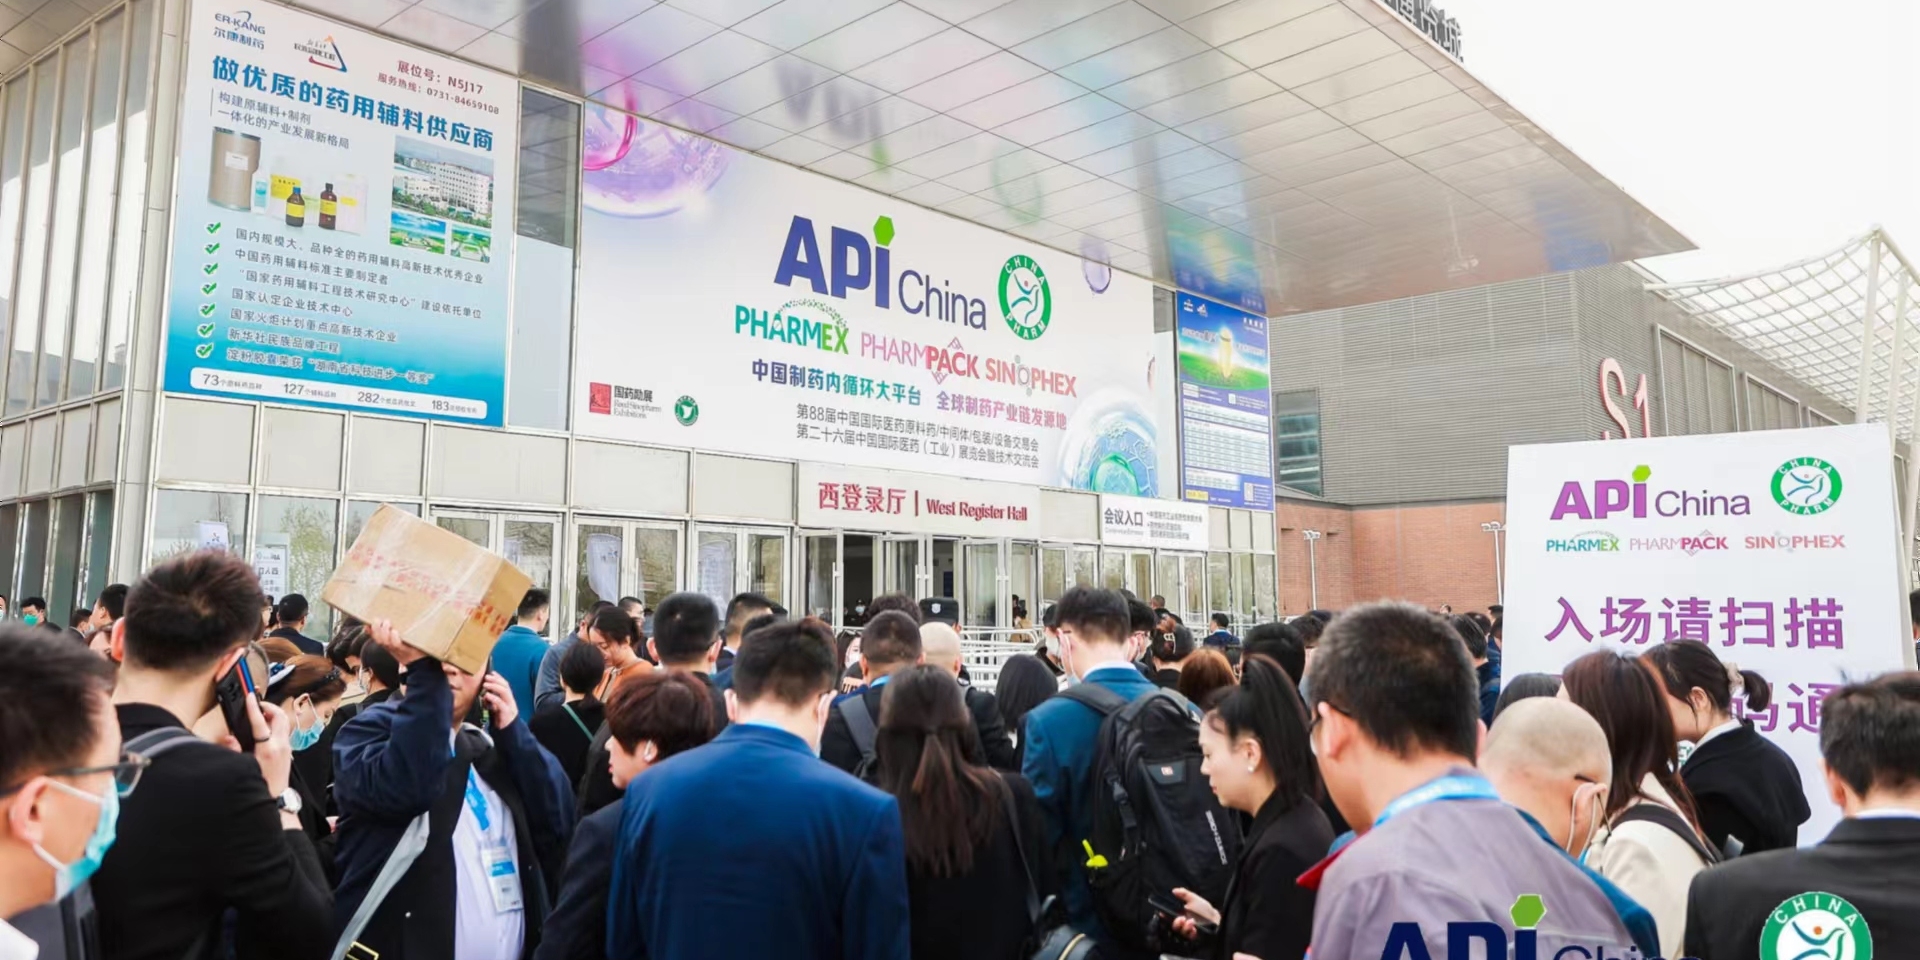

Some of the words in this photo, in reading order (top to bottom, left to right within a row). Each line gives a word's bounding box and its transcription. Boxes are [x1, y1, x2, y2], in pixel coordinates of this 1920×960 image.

[212, 55, 493, 151] 做优质的药用辅料供应商
[219, 91, 311, 125] 构建原辅料+制剂
[218, 109, 350, 149] 一体化的产业发展新格局
[235, 248, 388, 285] 中国药用辅料标准主要制定者
[1005, 256, 1044, 285] CHINA
[232, 288, 353, 317] 国家认定企业技术中心
[898, 269, 986, 331] China
[229, 329, 339, 353] 新华社民族品牌工程
[231, 308, 396, 342] 国家火炬计划重点高新技术企业
[1005, 311, 1047, 340] PHARM
[735, 304, 849, 355] PHARMEX
[861, 332, 980, 381] PHARMPACK
[985, 356, 1077, 398] SINOPHEX
[752, 359, 921, 406] 中国制药内循环大平台
[936, 390, 1067, 430] 全球制药产业链发源地
[1600, 357, 1651, 440] S1
[797, 403, 1039, 452] 第88届中国国际医药原料药/中间体/包装/设备交易会
[1779, 457, 1832, 474] CHINA
[818, 482, 907, 514] 西登录厅
[926, 498, 956, 516] West
[959, 501, 1005, 521] Register
[1007, 506, 1027, 521] Hall
[1104, 507, 1143, 527] 会议入口
[1655, 489, 1751, 517] China
[1780, 497, 1834, 515] PHARM
[1546, 537, 1620, 552] PHARMEX
[1630, 536, 1729, 551] PHARMPACK
[1745, 534, 1846, 550] SINOPHEX
[1544, 596, 1844, 650] 入场请扫描
